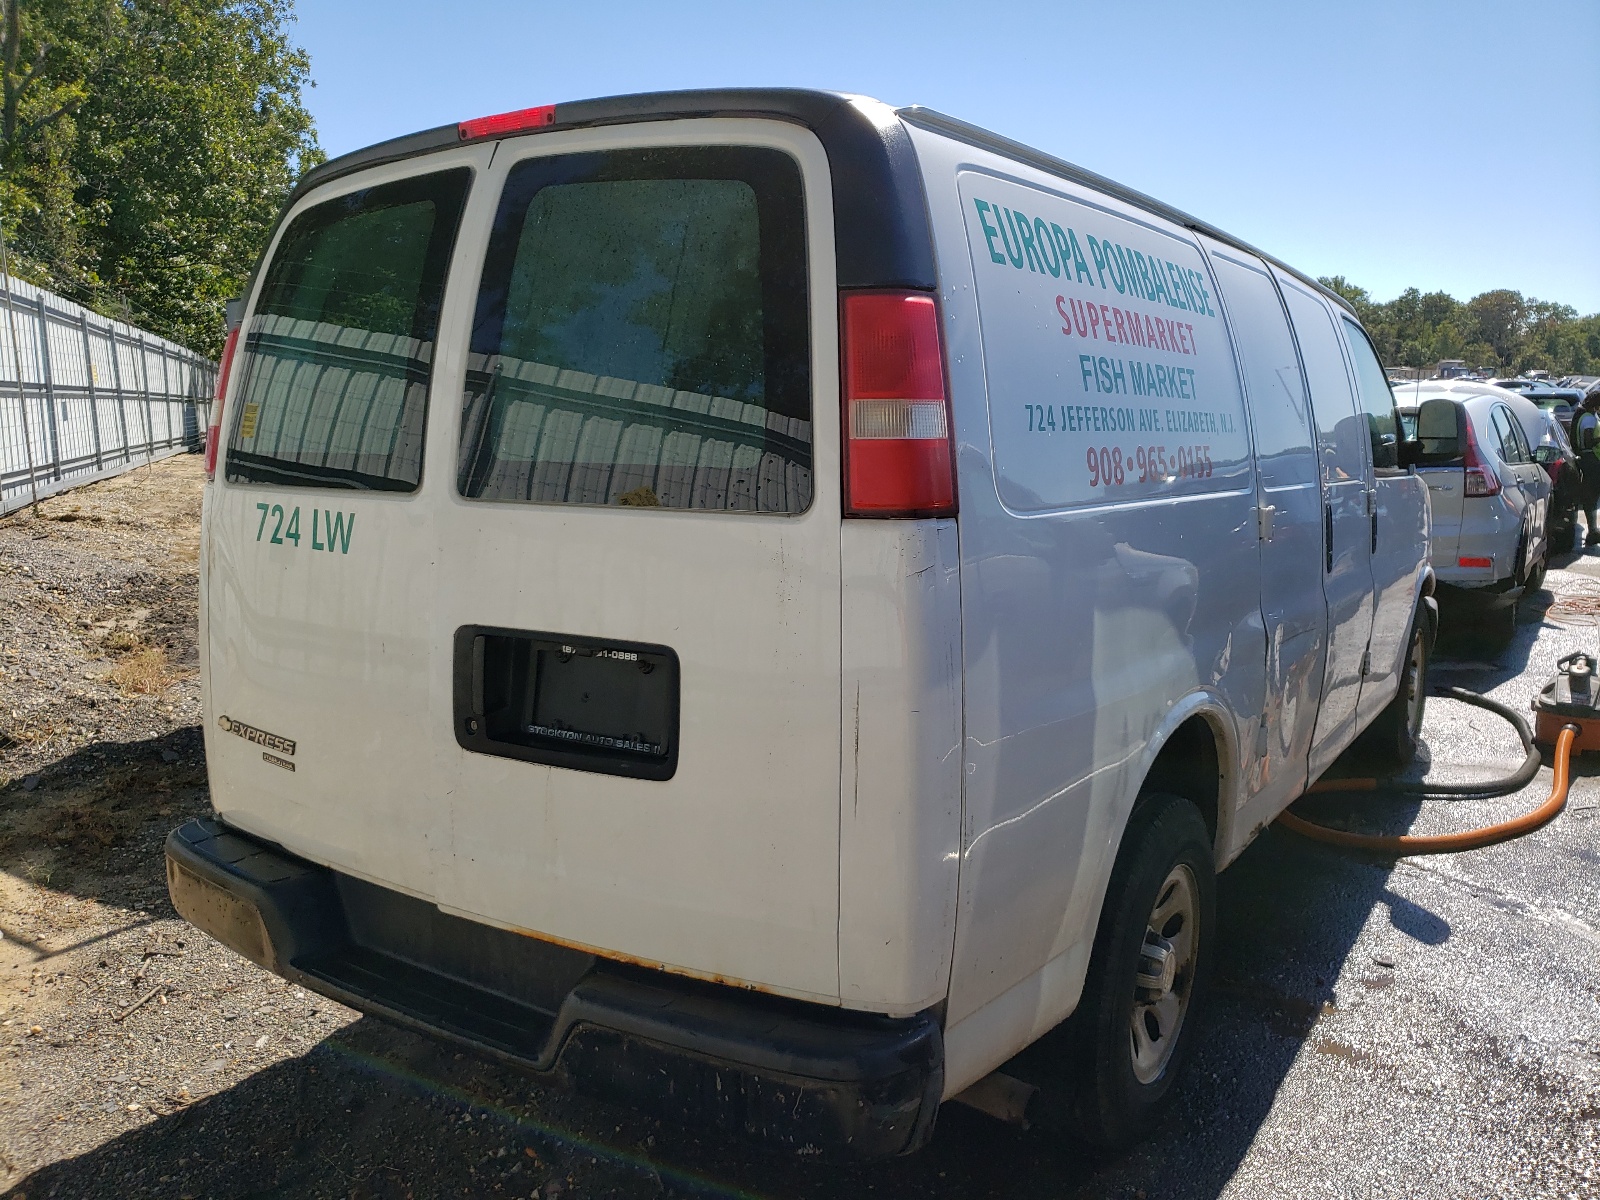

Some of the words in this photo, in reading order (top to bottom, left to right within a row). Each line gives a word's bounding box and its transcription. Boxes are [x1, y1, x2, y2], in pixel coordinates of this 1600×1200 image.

[973, 197, 1095, 287] EUROPA
[1086, 233, 1216, 318] POMBALENSE
[1055, 294, 1198, 356] SUPERMARKET
[1079, 355, 1128, 395] FISH
[1129, 360, 1197, 401] MARKET
[1025, 404, 1056, 432] 724
[1061, 405, 1135, 432] JEFFERSON
[1139, 408, 1164, 432] AVE.
[256, 502, 301, 547] 724
[312, 508, 356, 555] LW
[231, 720, 297, 756] EXPRESS
[528, 725, 582, 740] STOCKTON
[585, 734, 614, 746] AUTO
[616, 739, 651, 752] SALES
